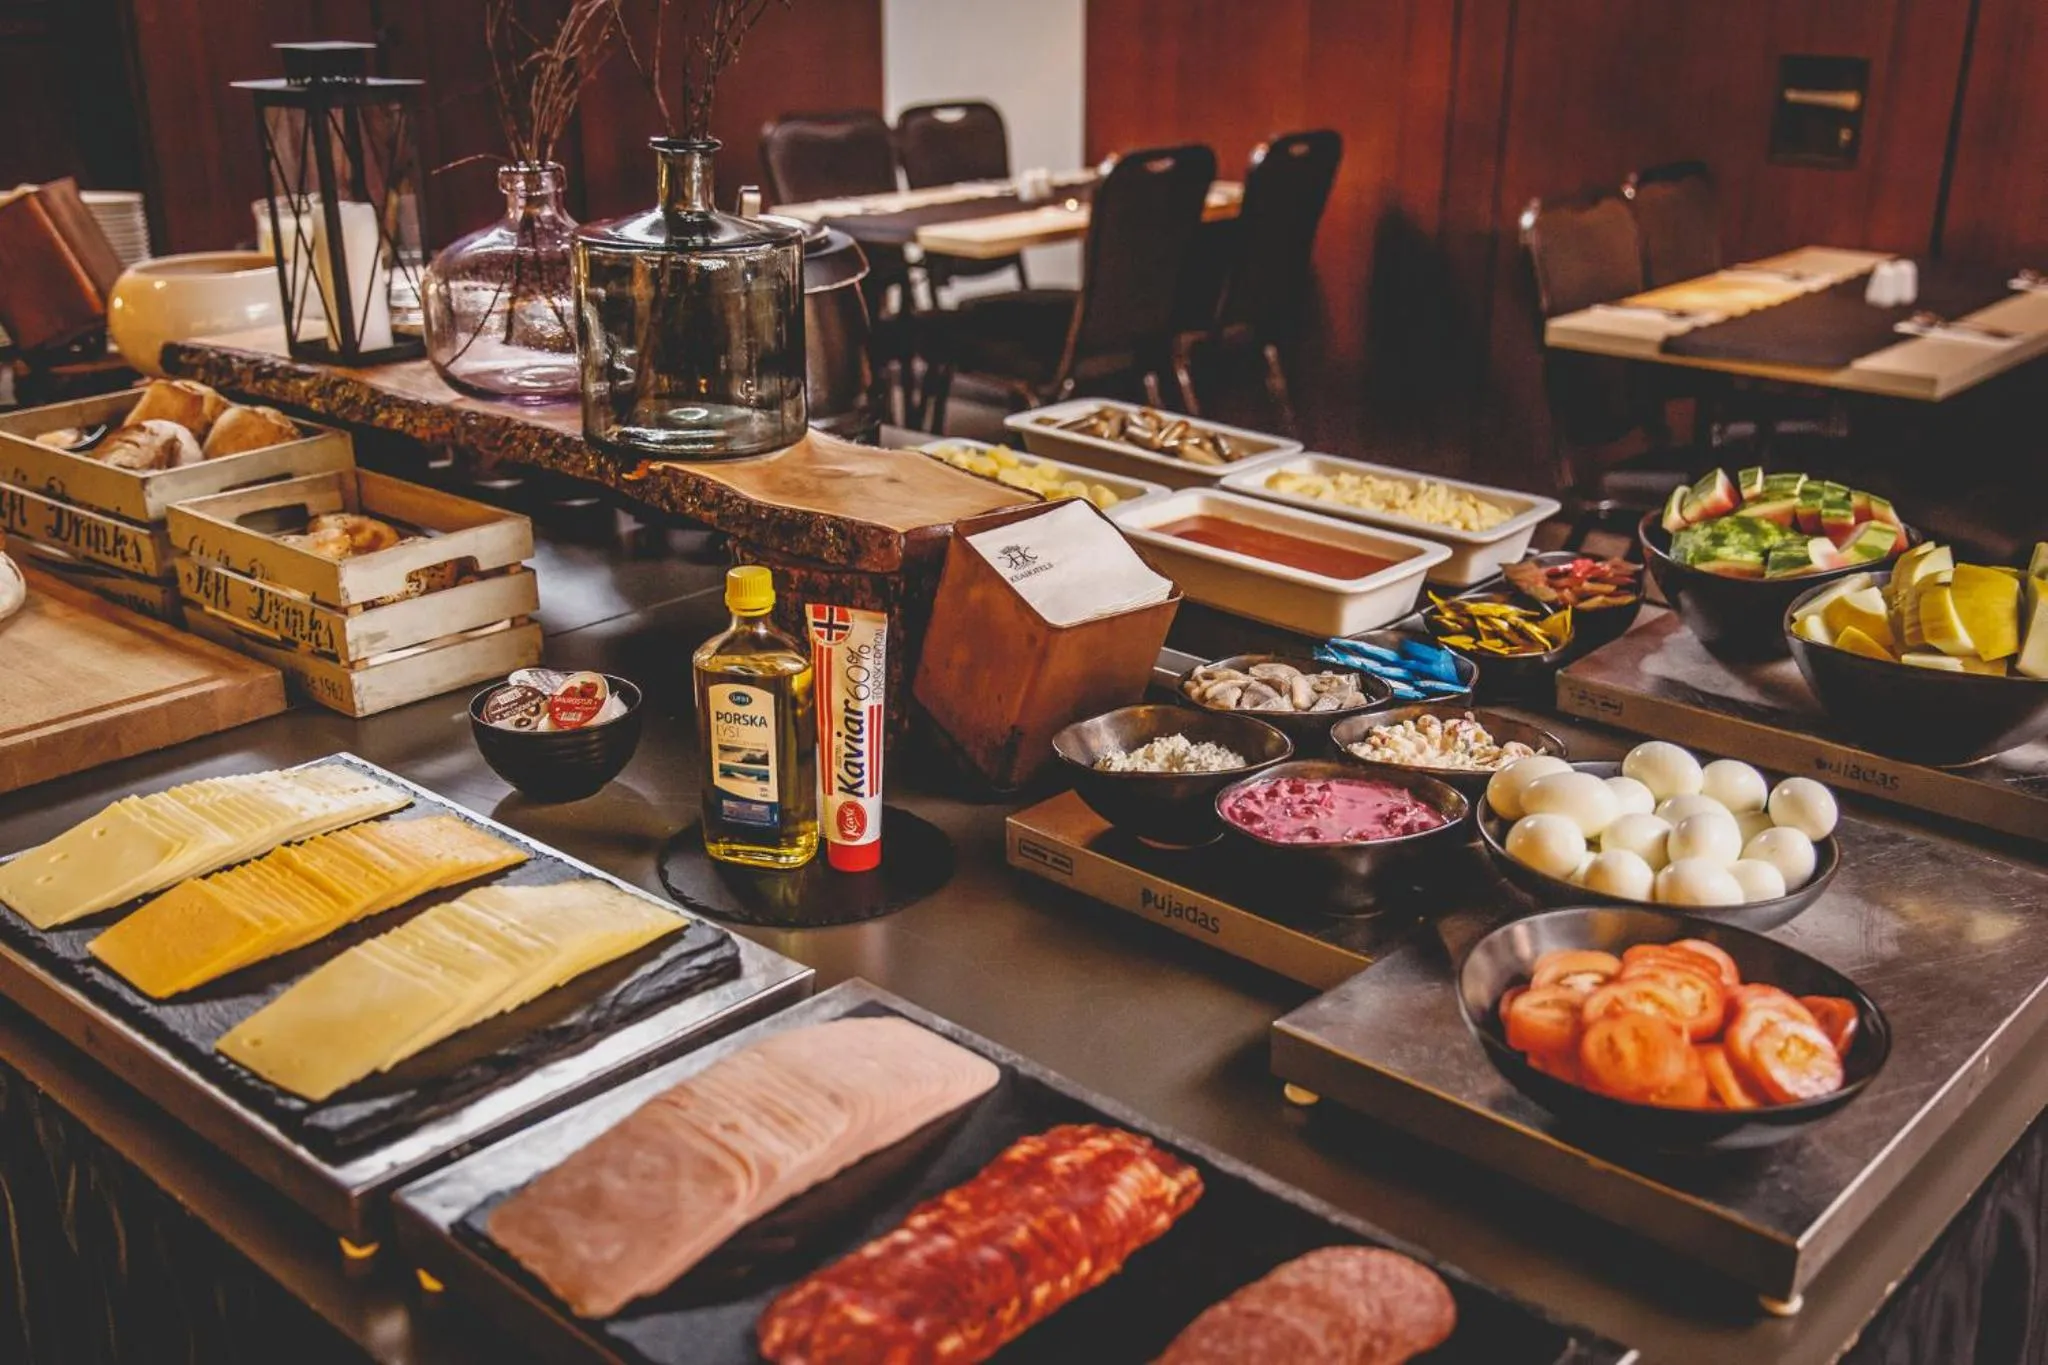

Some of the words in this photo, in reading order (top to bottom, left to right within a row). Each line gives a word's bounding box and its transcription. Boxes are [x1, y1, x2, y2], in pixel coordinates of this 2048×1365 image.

[46, 476, 147, 566] Drinks
[187, 535, 231, 608] Soft
[247, 558, 336, 649] Drinks
[846, 644, 870, 701] 60%
[837, 698, 865, 798] Kaviar
[1142, 887, 1220, 934] pujadas
